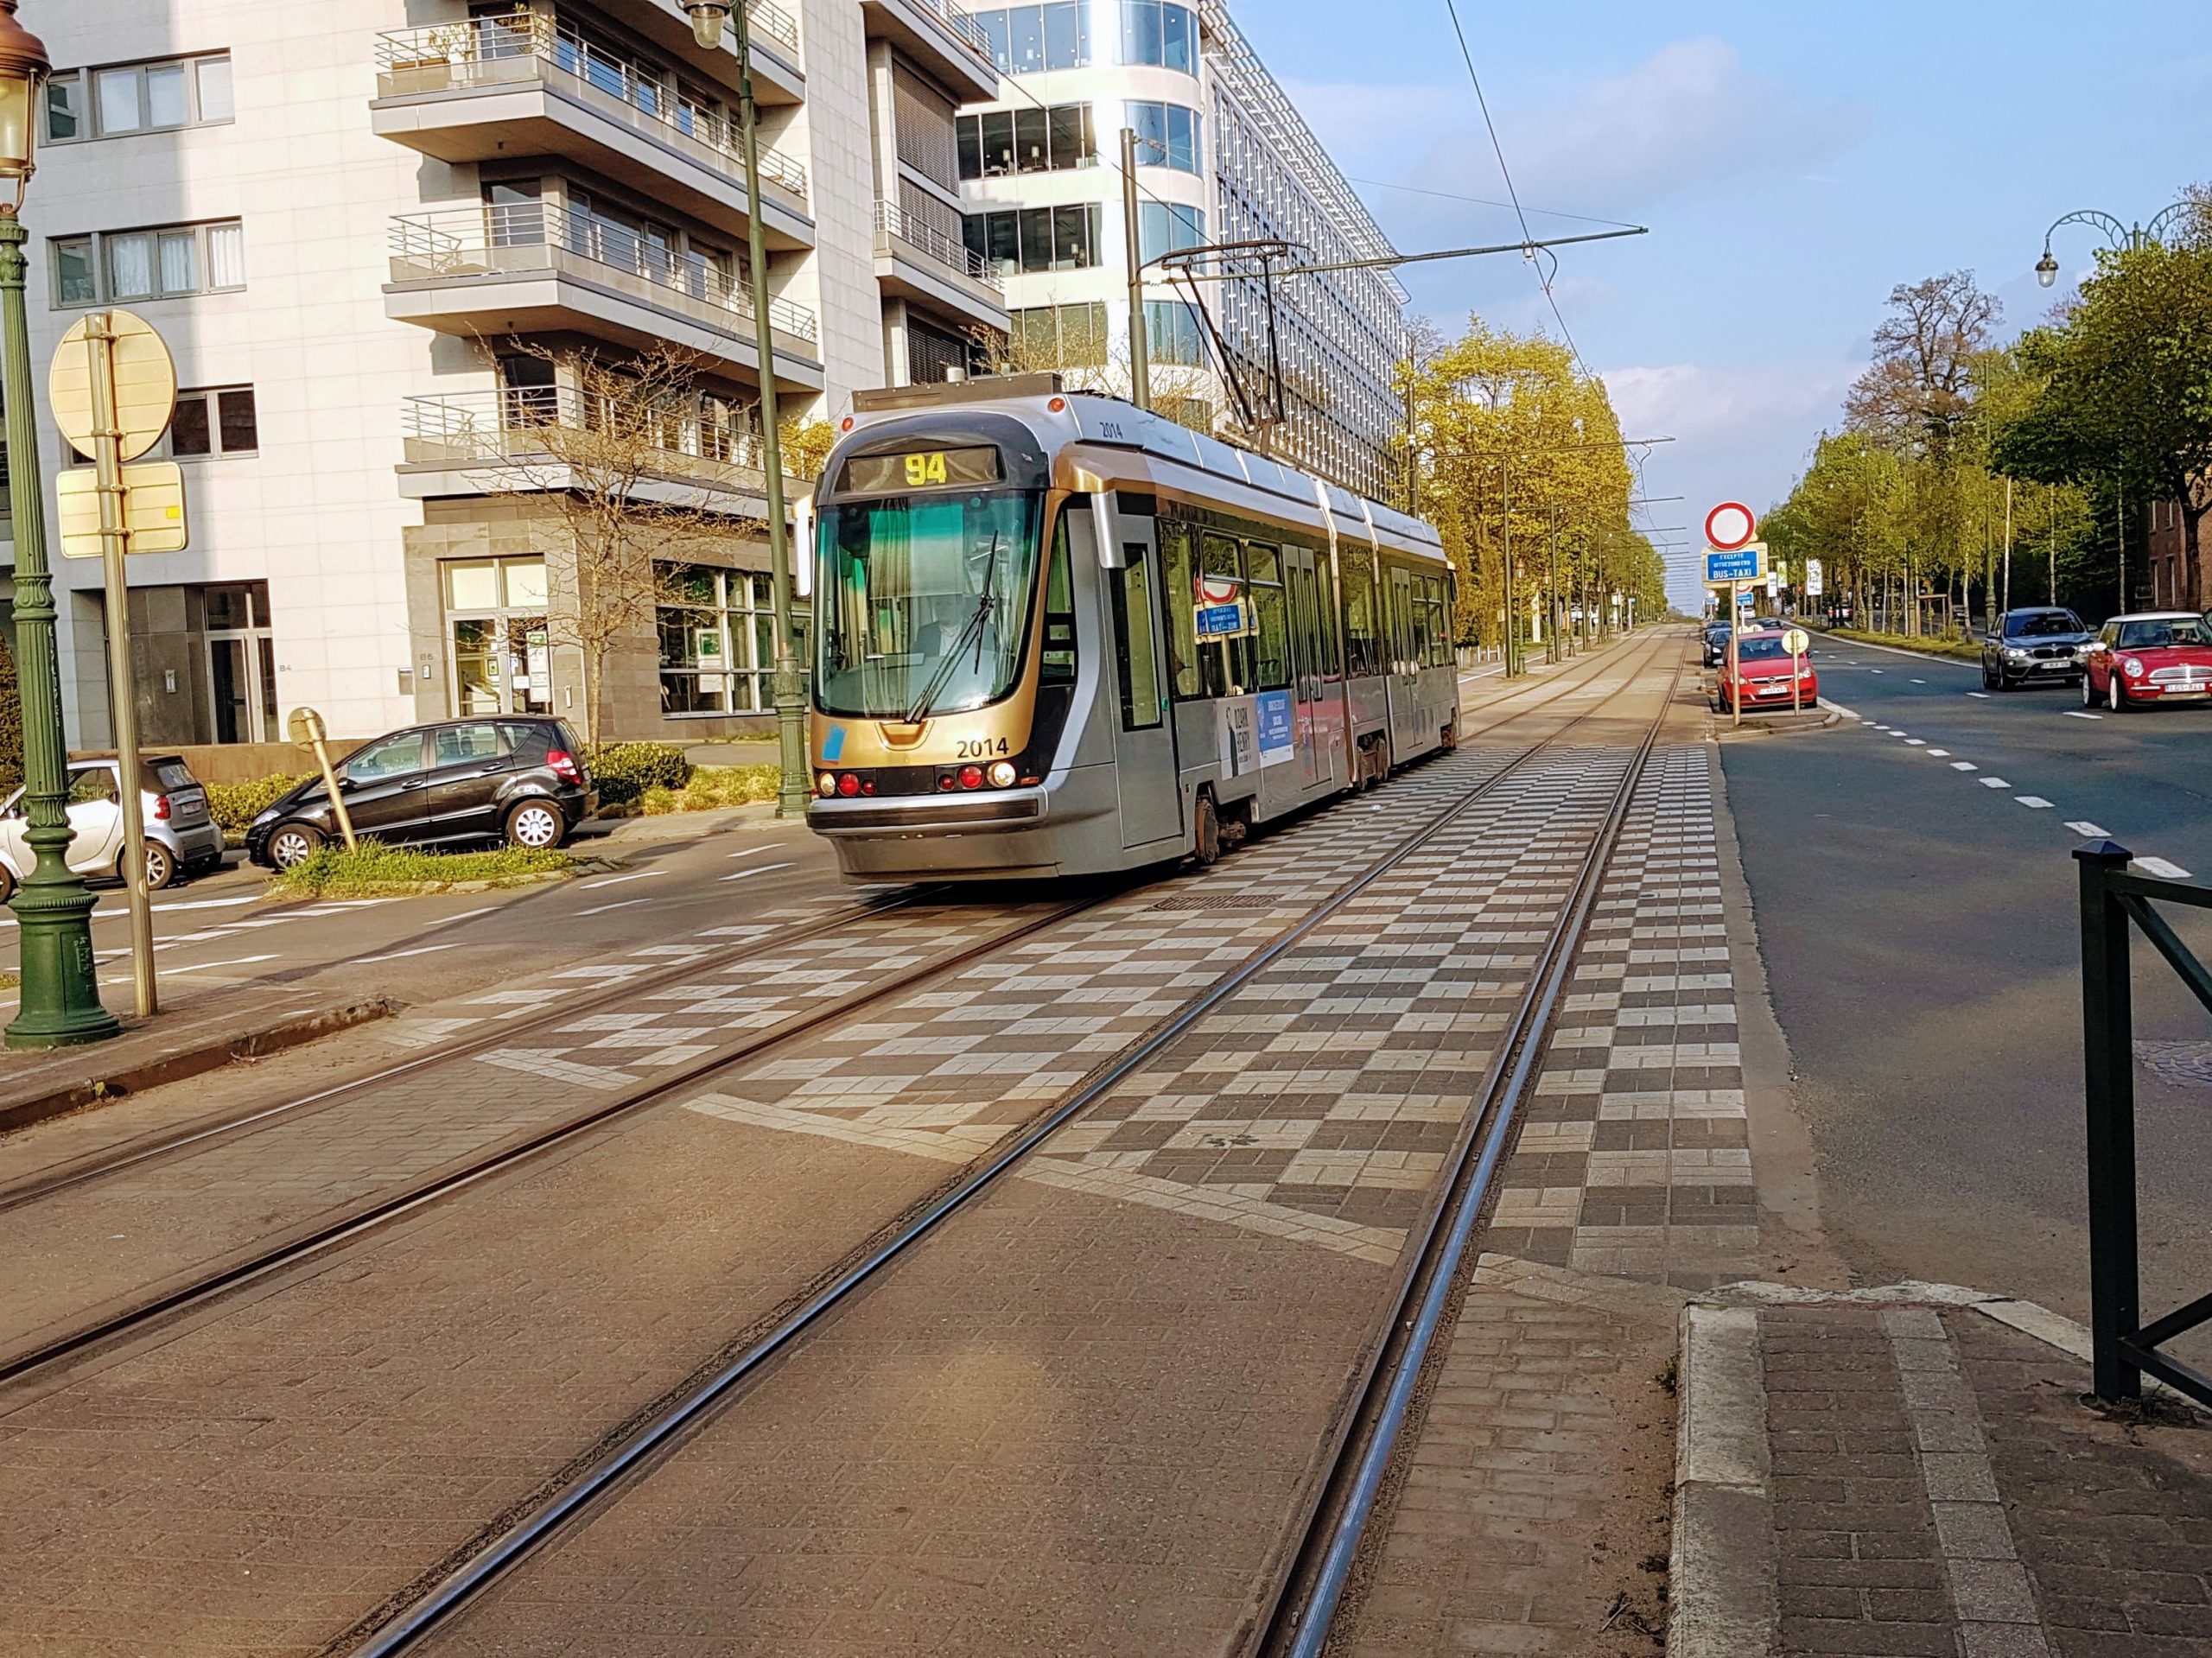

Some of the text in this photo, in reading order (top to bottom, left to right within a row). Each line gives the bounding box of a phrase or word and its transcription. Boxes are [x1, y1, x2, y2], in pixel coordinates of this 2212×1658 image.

[1099, 422, 1123, 439] 2014
[906, 453, 947, 486] 94
[1713, 569, 1752, 579] BUS-TAXI
[957, 737, 1009, 759] 2014
